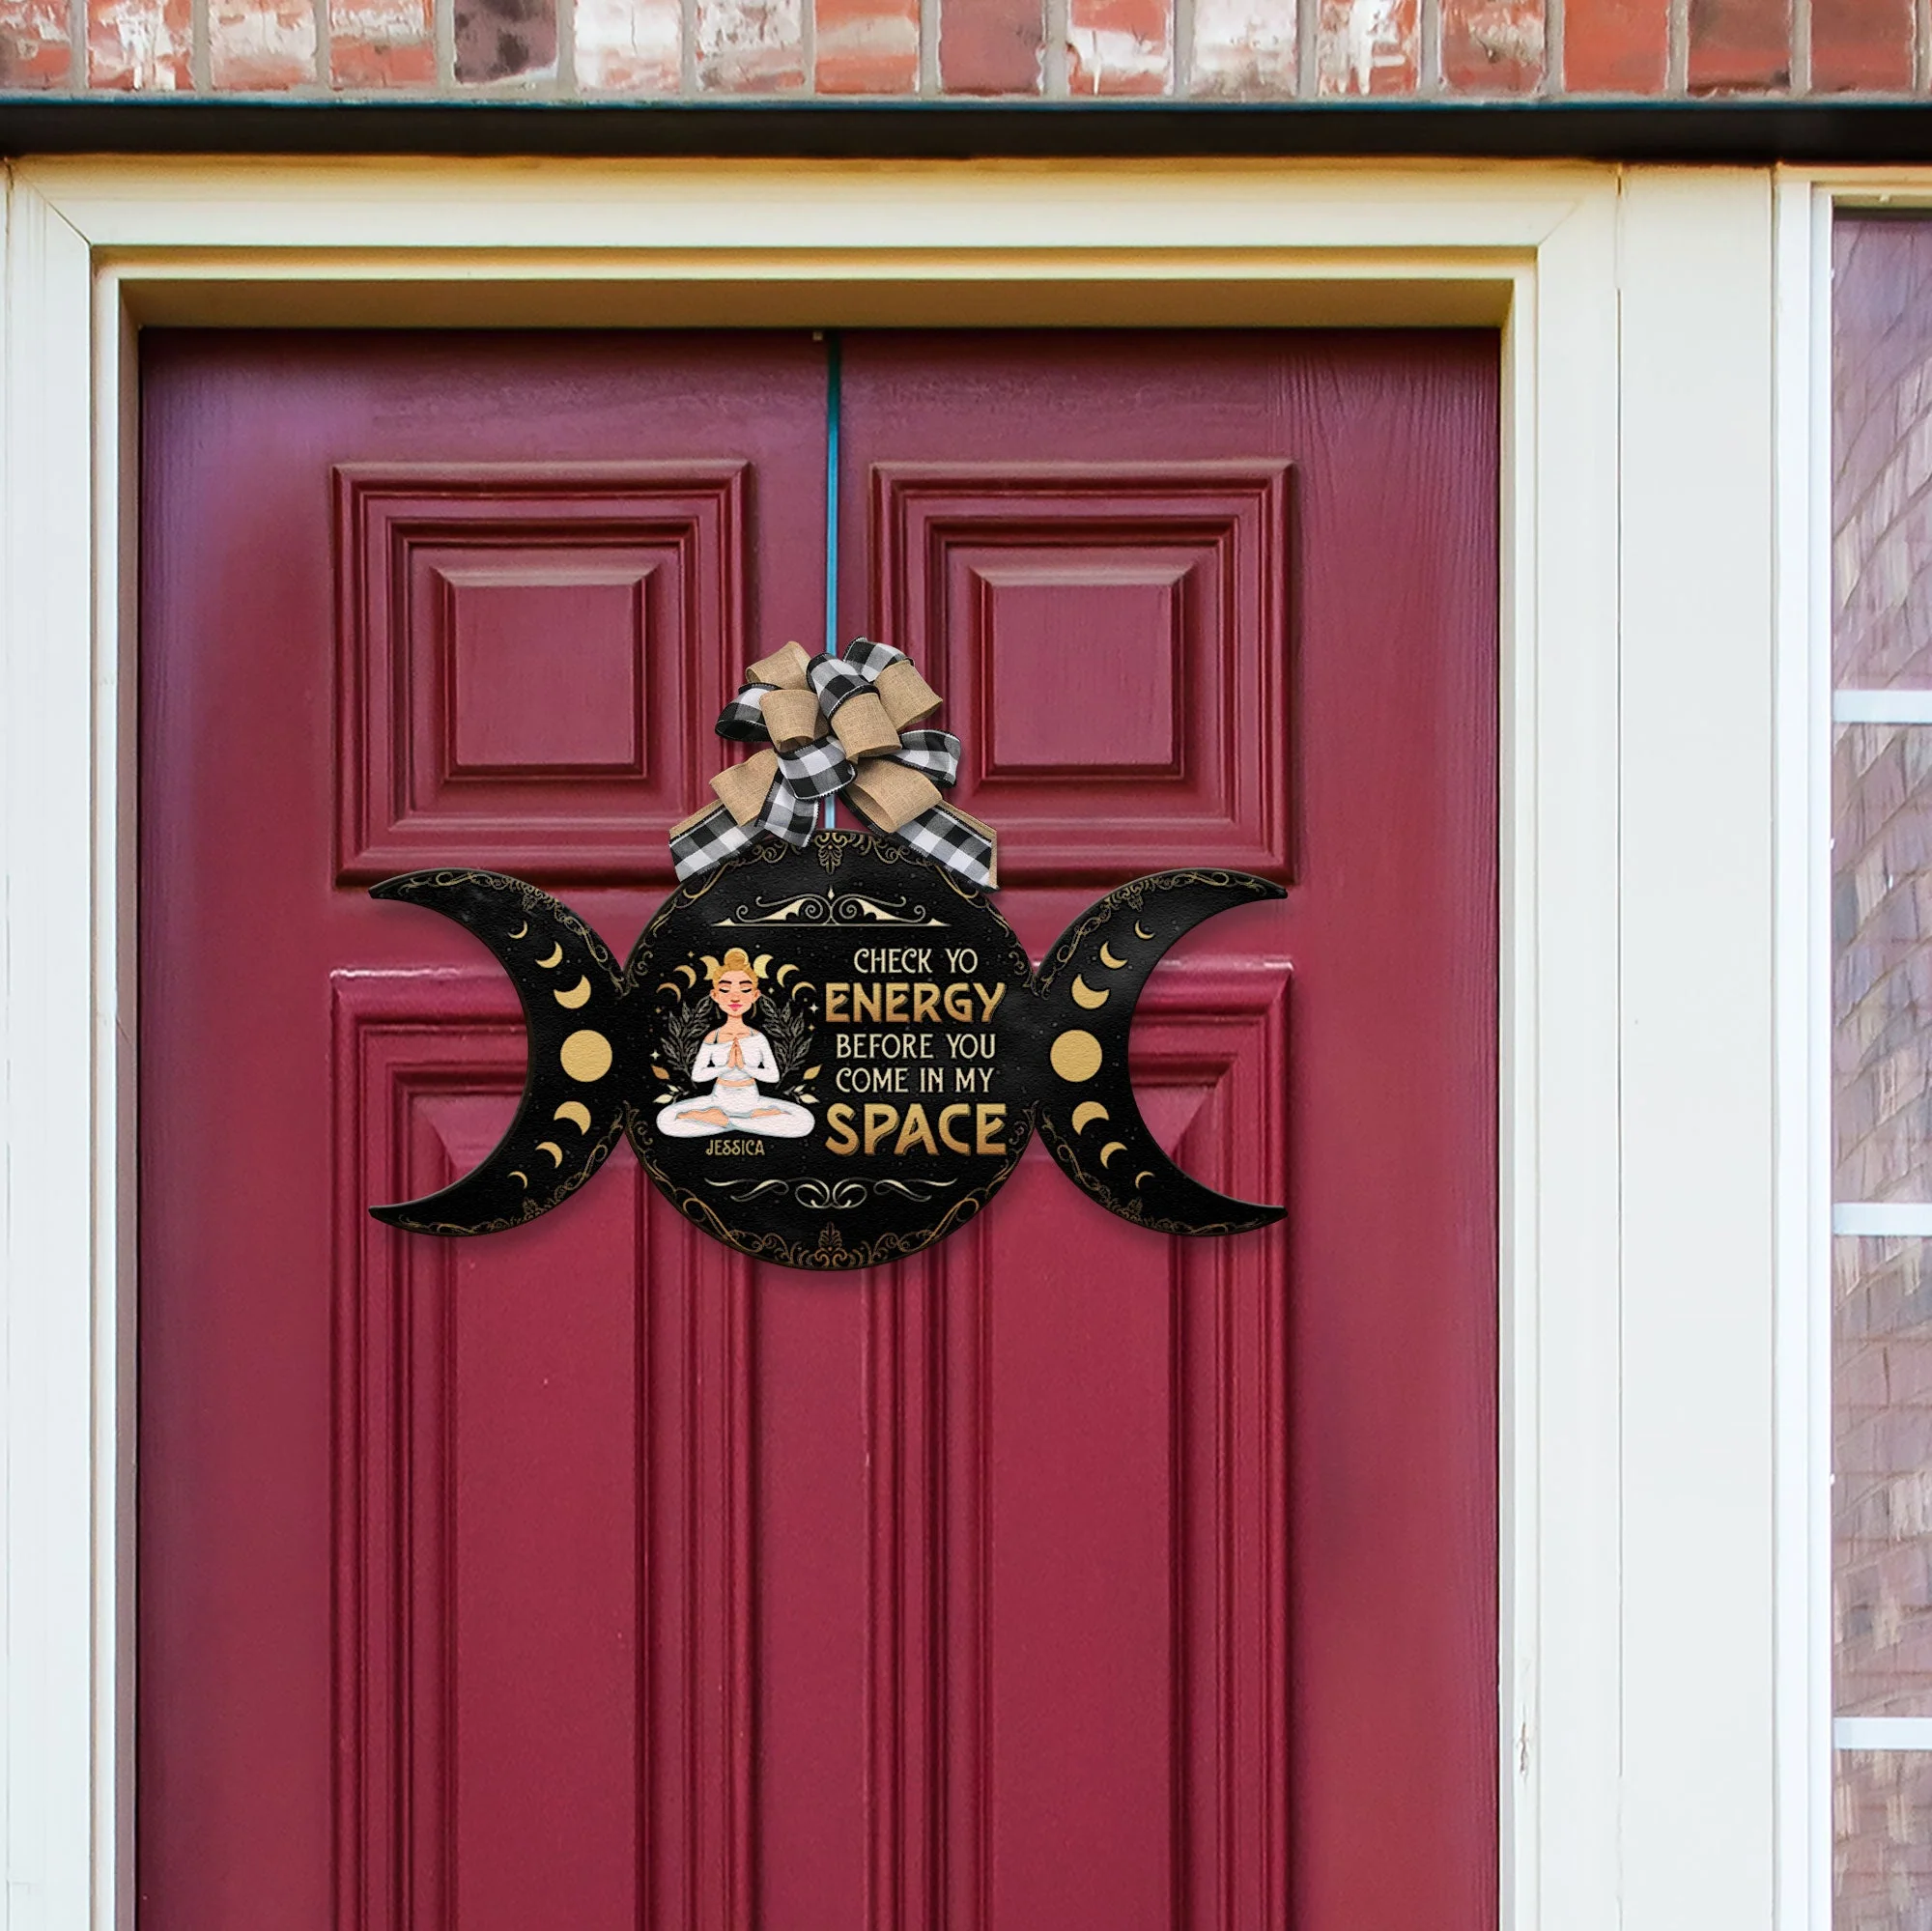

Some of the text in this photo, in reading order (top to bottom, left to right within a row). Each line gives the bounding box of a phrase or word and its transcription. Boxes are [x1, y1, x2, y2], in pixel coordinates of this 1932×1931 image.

[854, 948, 979, 974] CHECK YO
[825, 982, 1007, 1023] ENERGY
[836, 1034, 996, 1060] BEFORE YOU
[836, 1067, 994, 1093] COME IN MY
[825, 1103, 1008, 1156] SPACE
[705, 1138, 765, 1156] JESSICA
